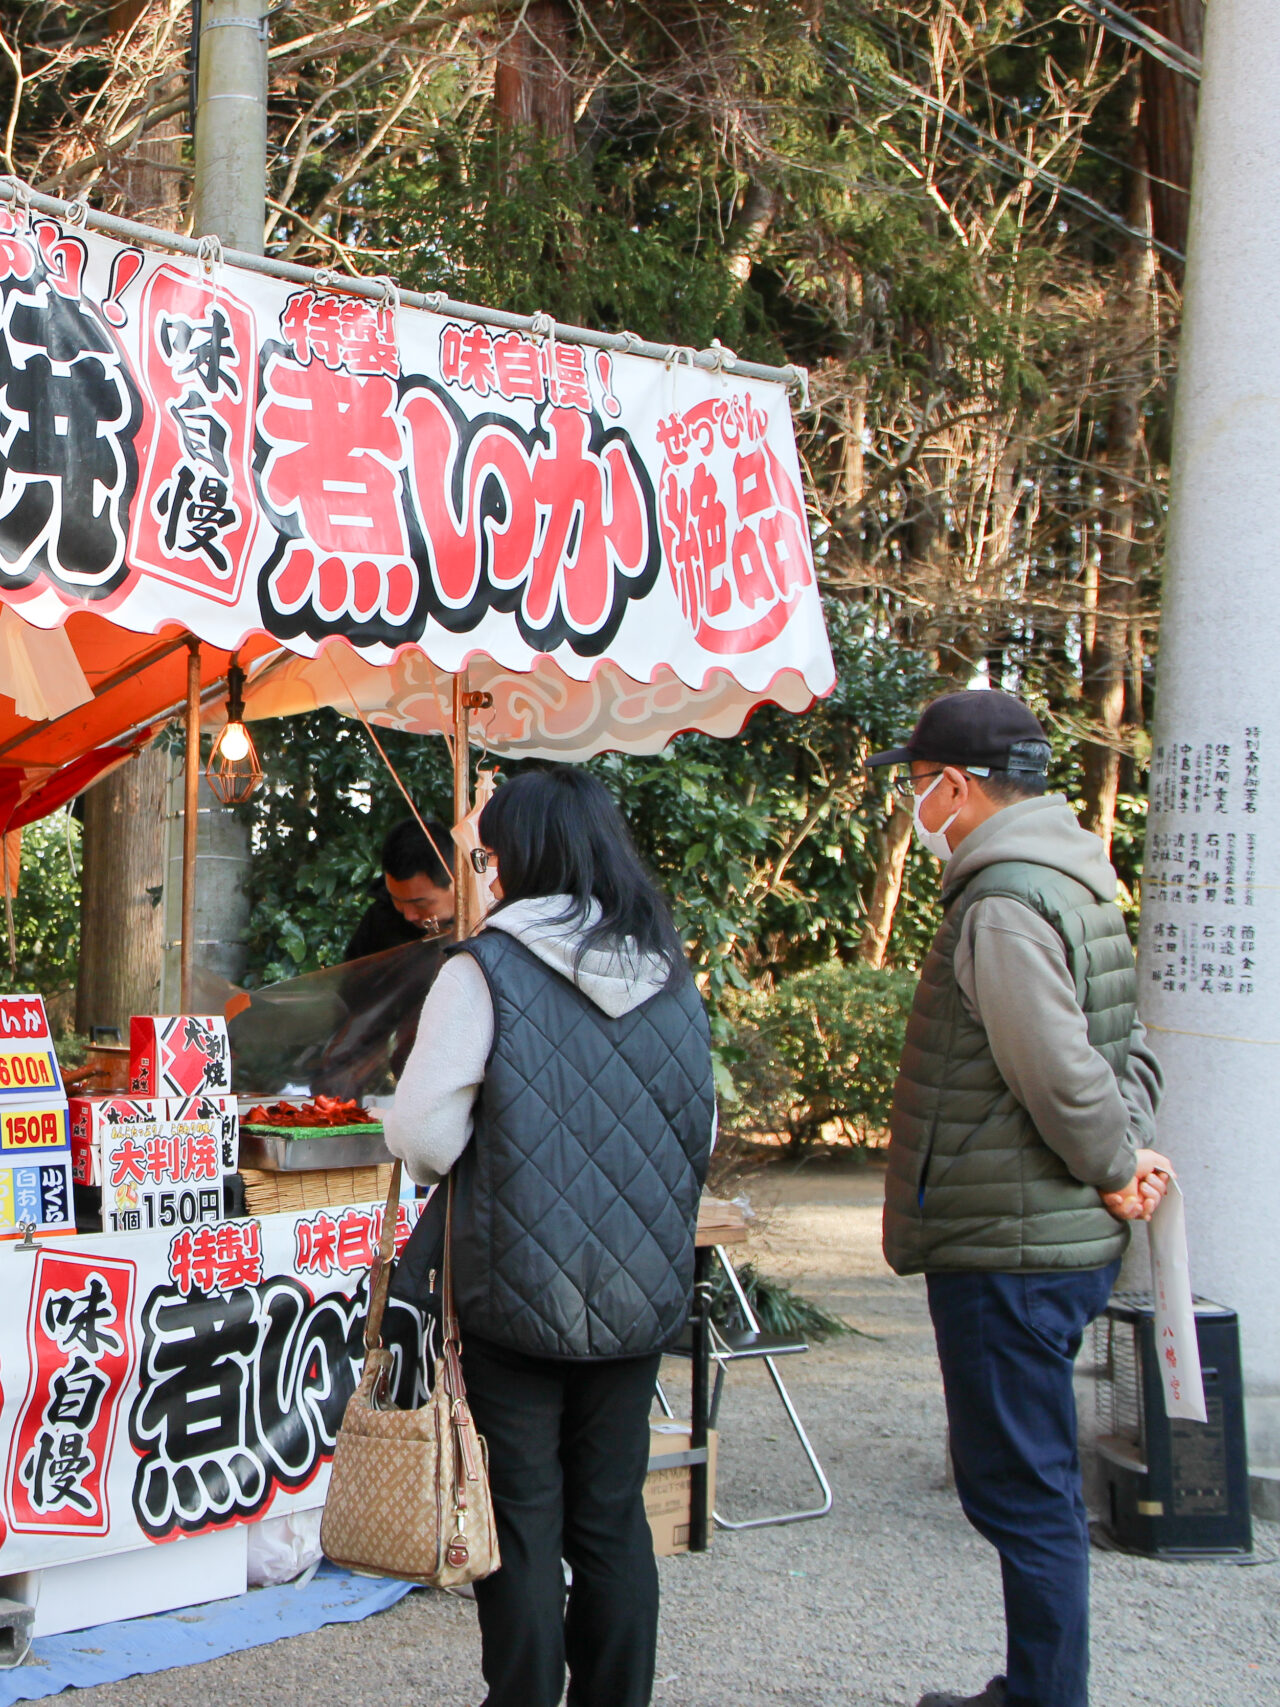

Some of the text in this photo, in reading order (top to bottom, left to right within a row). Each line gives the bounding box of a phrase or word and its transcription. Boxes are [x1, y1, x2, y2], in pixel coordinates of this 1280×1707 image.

[281, 289, 620, 418] 特製 味自慢！
[159, 309, 236, 573] 味自慢
[655, 392, 770, 463] ぜっぴん
[258, 341, 656, 656] 煮いか
[664, 450, 812, 626] 絶品
[182, 1019, 228, 1090] 大判焼
[5, 1113, 58, 1145] 150円
[110, 1134, 218, 1187] 大判焼
[16, 1169, 38, 1224] 白あん
[109, 1188, 221, 1231] 1個 150円
[169, 1204, 425, 1296] 特製 味自慢
[23, 1278, 119, 1510] 味自慢
